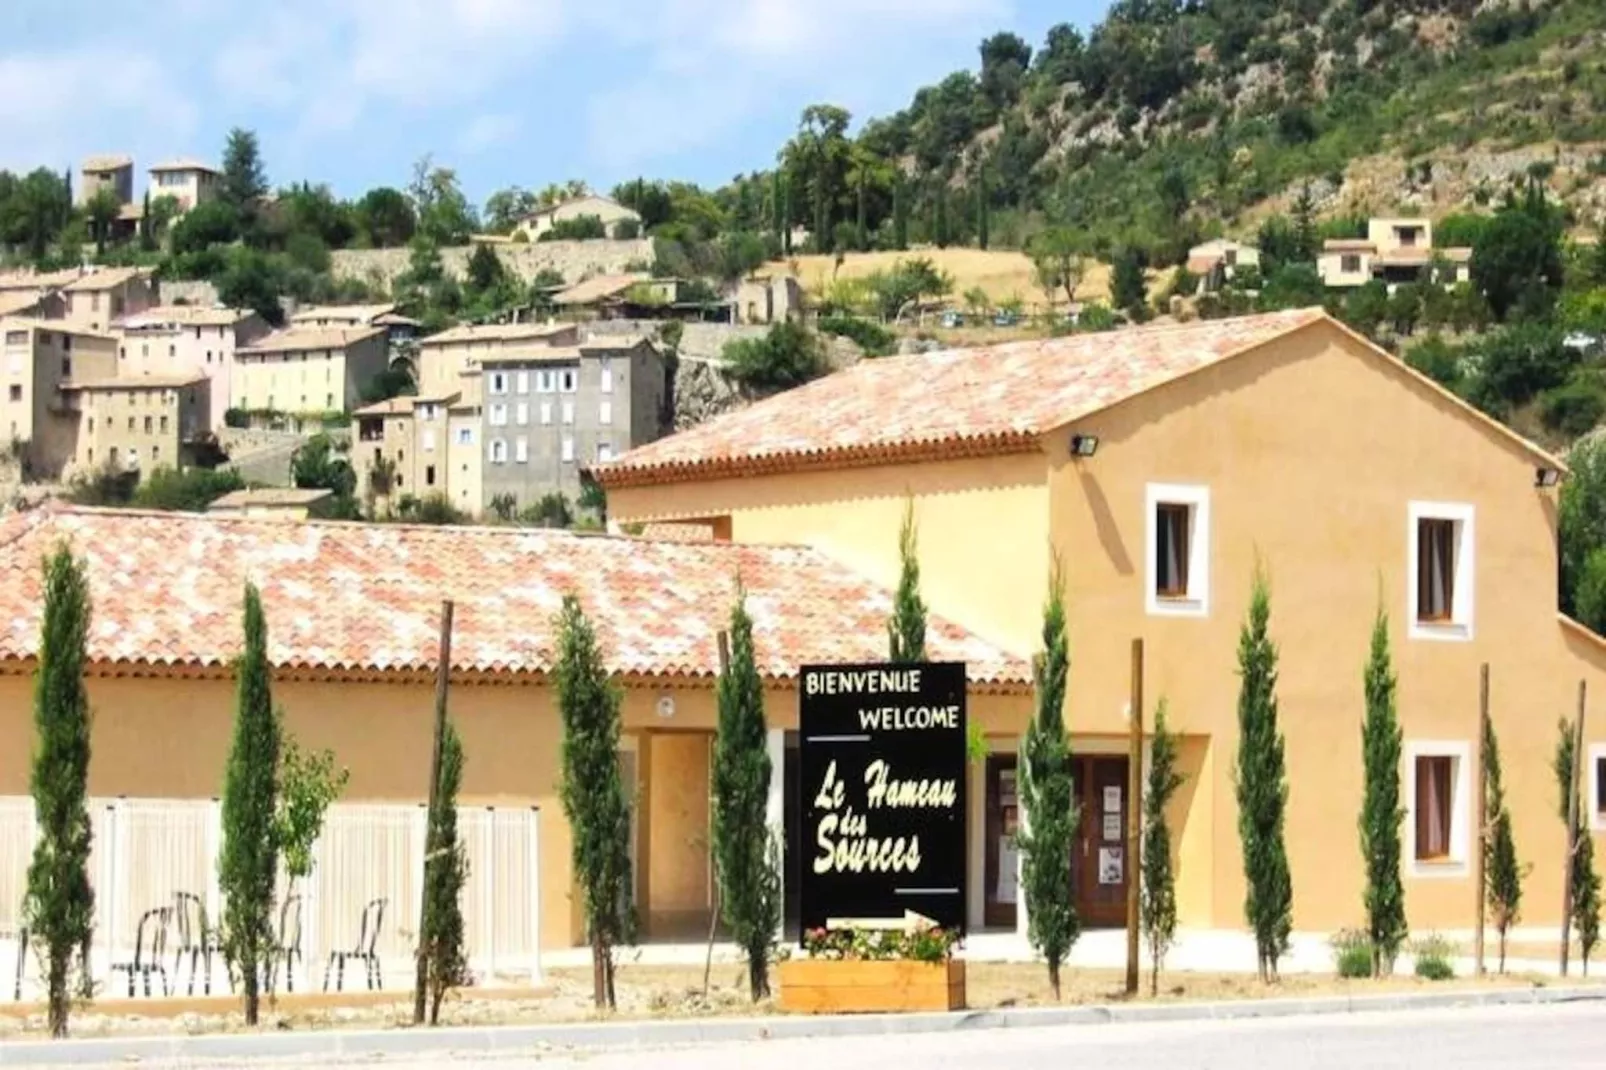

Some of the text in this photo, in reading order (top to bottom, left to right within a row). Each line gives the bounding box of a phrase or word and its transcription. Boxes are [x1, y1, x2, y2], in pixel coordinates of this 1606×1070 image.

[806, 670, 921, 695] BIENVENUE
[858, 706, 959, 730] WELCOME
[814, 759, 957, 809] Le Hameau
[840, 806, 867, 837] des
[813, 813, 921, 874] Sources
